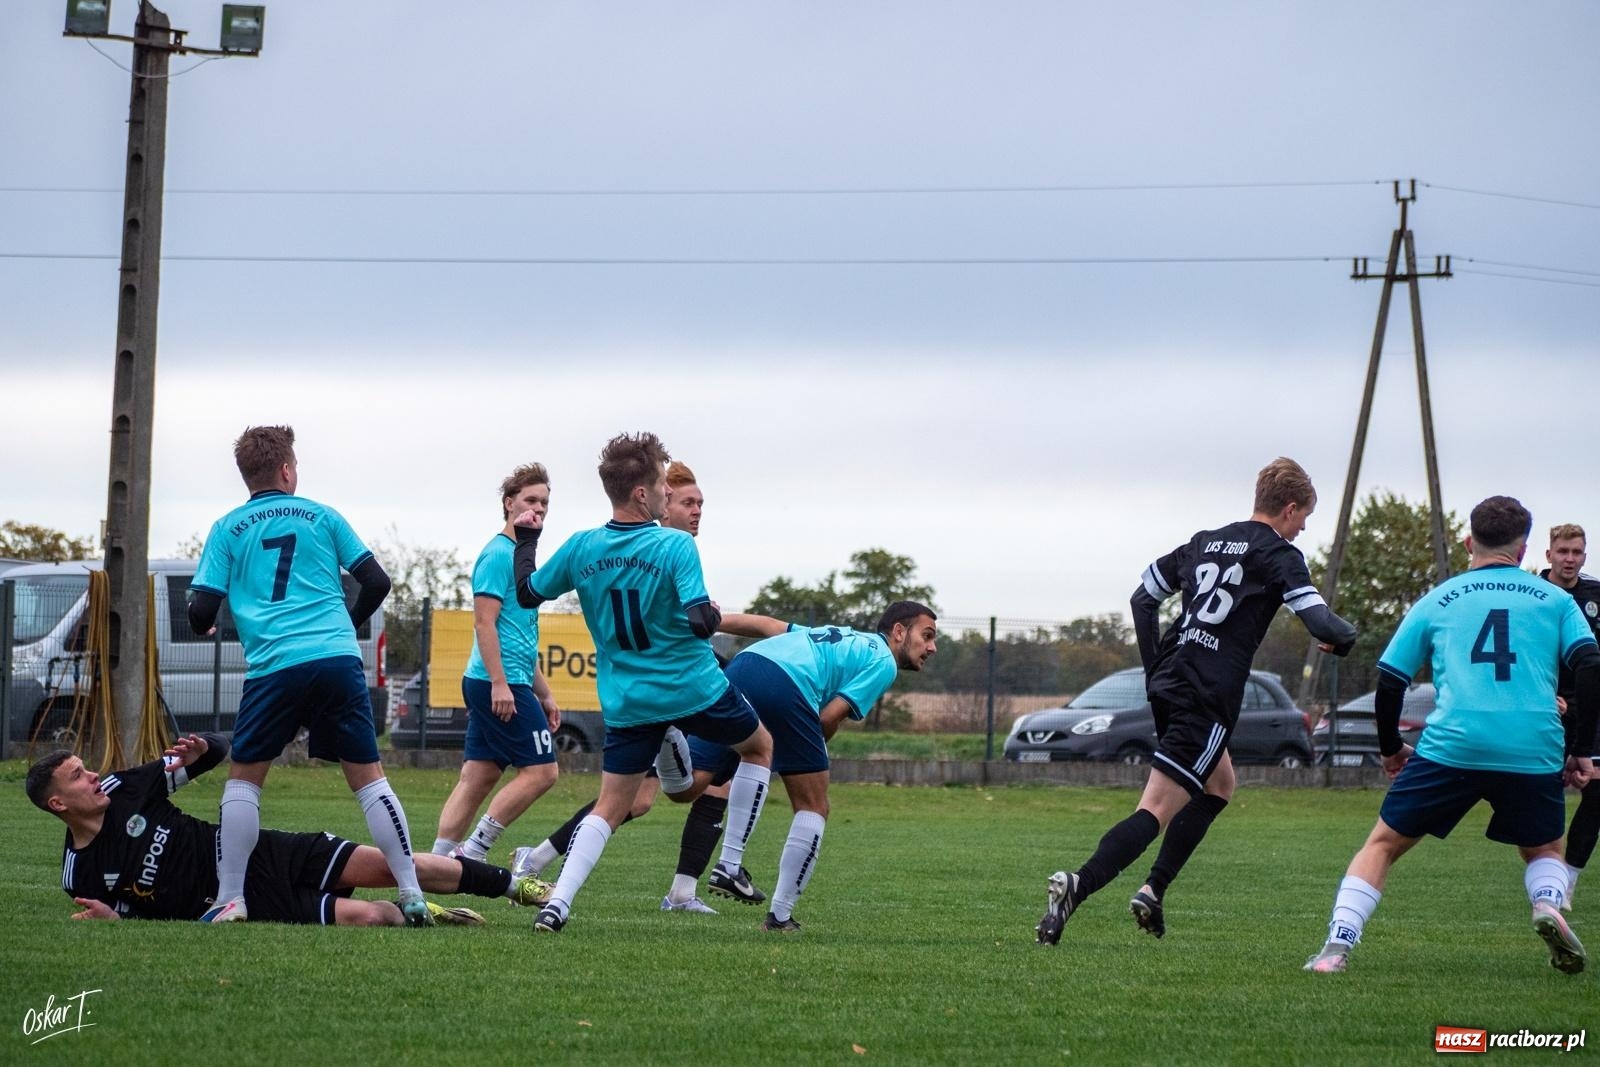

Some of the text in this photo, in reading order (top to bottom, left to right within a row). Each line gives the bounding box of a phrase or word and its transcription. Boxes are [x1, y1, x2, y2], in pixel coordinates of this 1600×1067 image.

[231, 507, 318, 537] LKS ZWONOWICE
[1204, 541, 1223, 553] LKS
[261, 533, 297, 603] 7
[580, 557, 662, 580] LKS ZWONOWICE
[1181, 562, 1244, 628] 26
[1438, 582, 1549, 608] LKS ZWONOWICE
[609, 588, 652, 652] 11
[1470, 608, 1517, 682] 4
[532, 729, 552, 755] 19
[138, 825, 171, 886] InPost
[1338, 927, 1356, 943] FS
